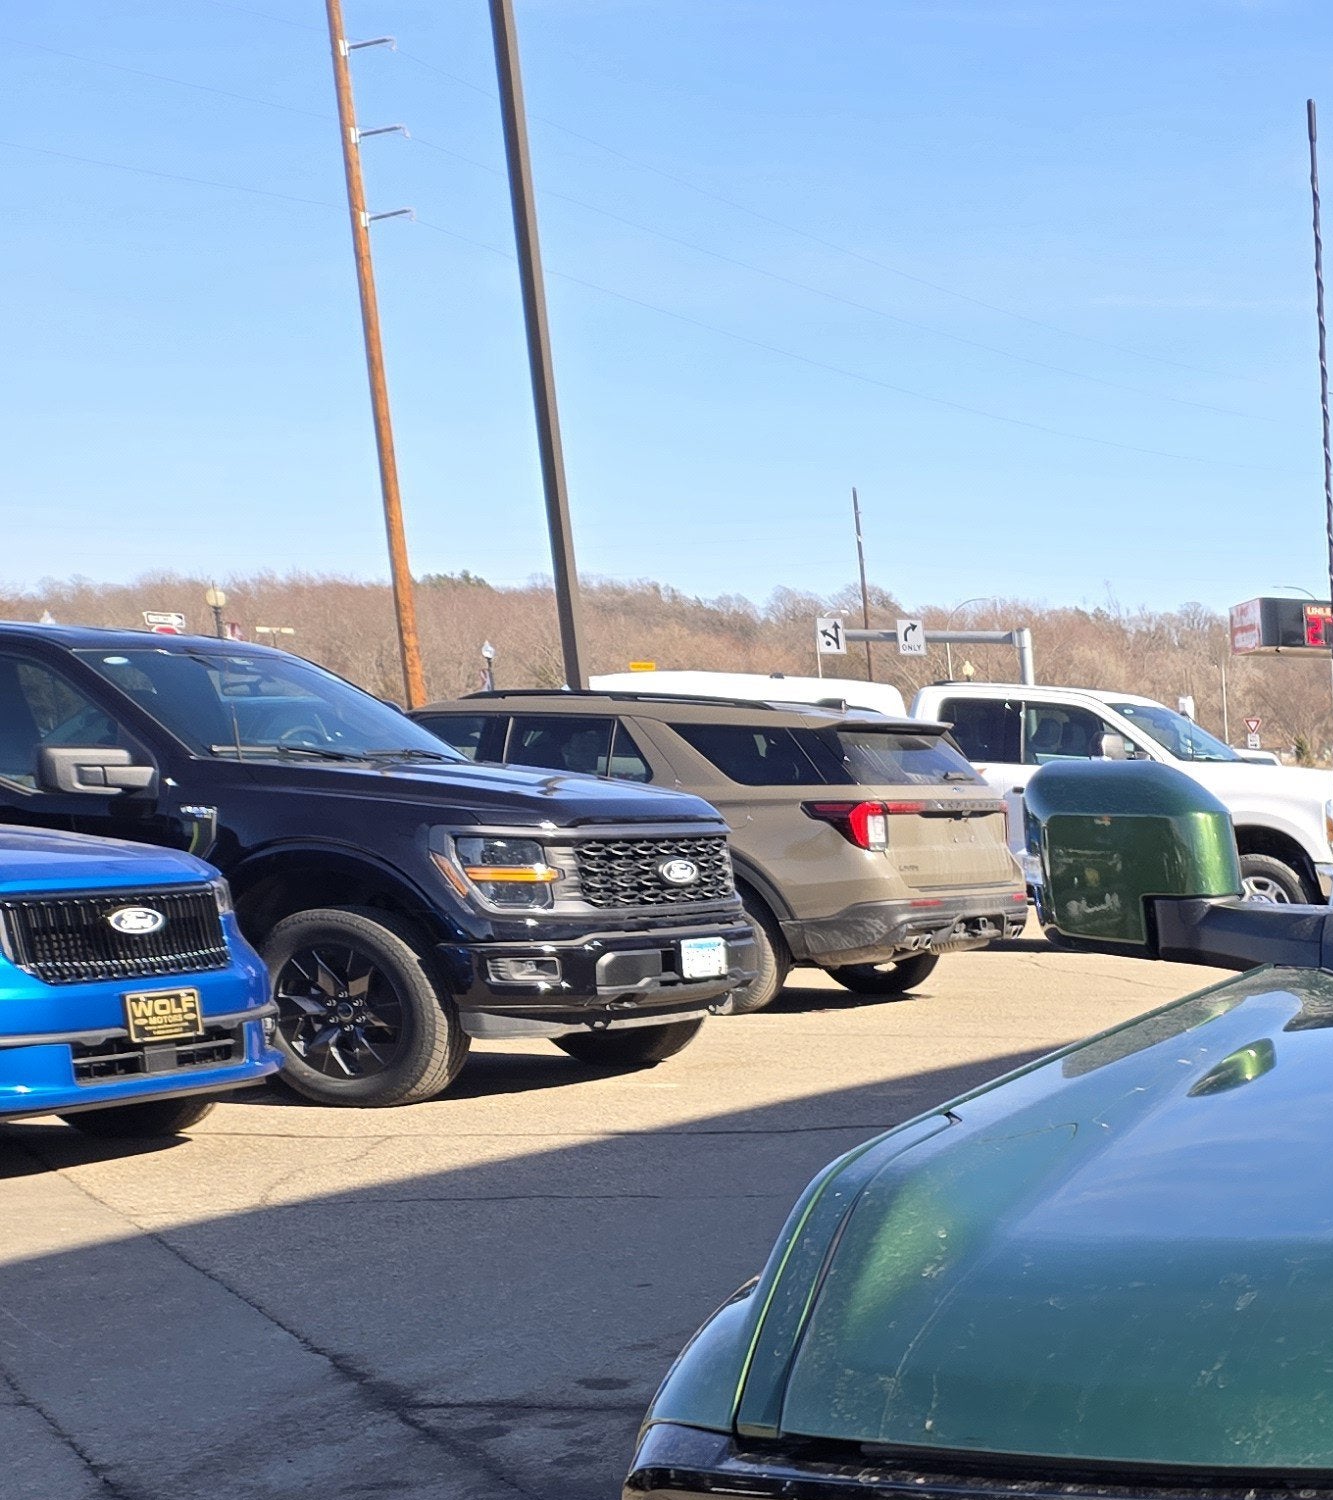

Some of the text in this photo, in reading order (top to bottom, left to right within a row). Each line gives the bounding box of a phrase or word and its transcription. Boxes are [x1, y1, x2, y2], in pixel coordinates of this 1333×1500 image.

[901, 643, 922, 652] ONLY
[131, 996, 195, 1018] WOLF
[148, 1013, 184, 1025] MOTORS
